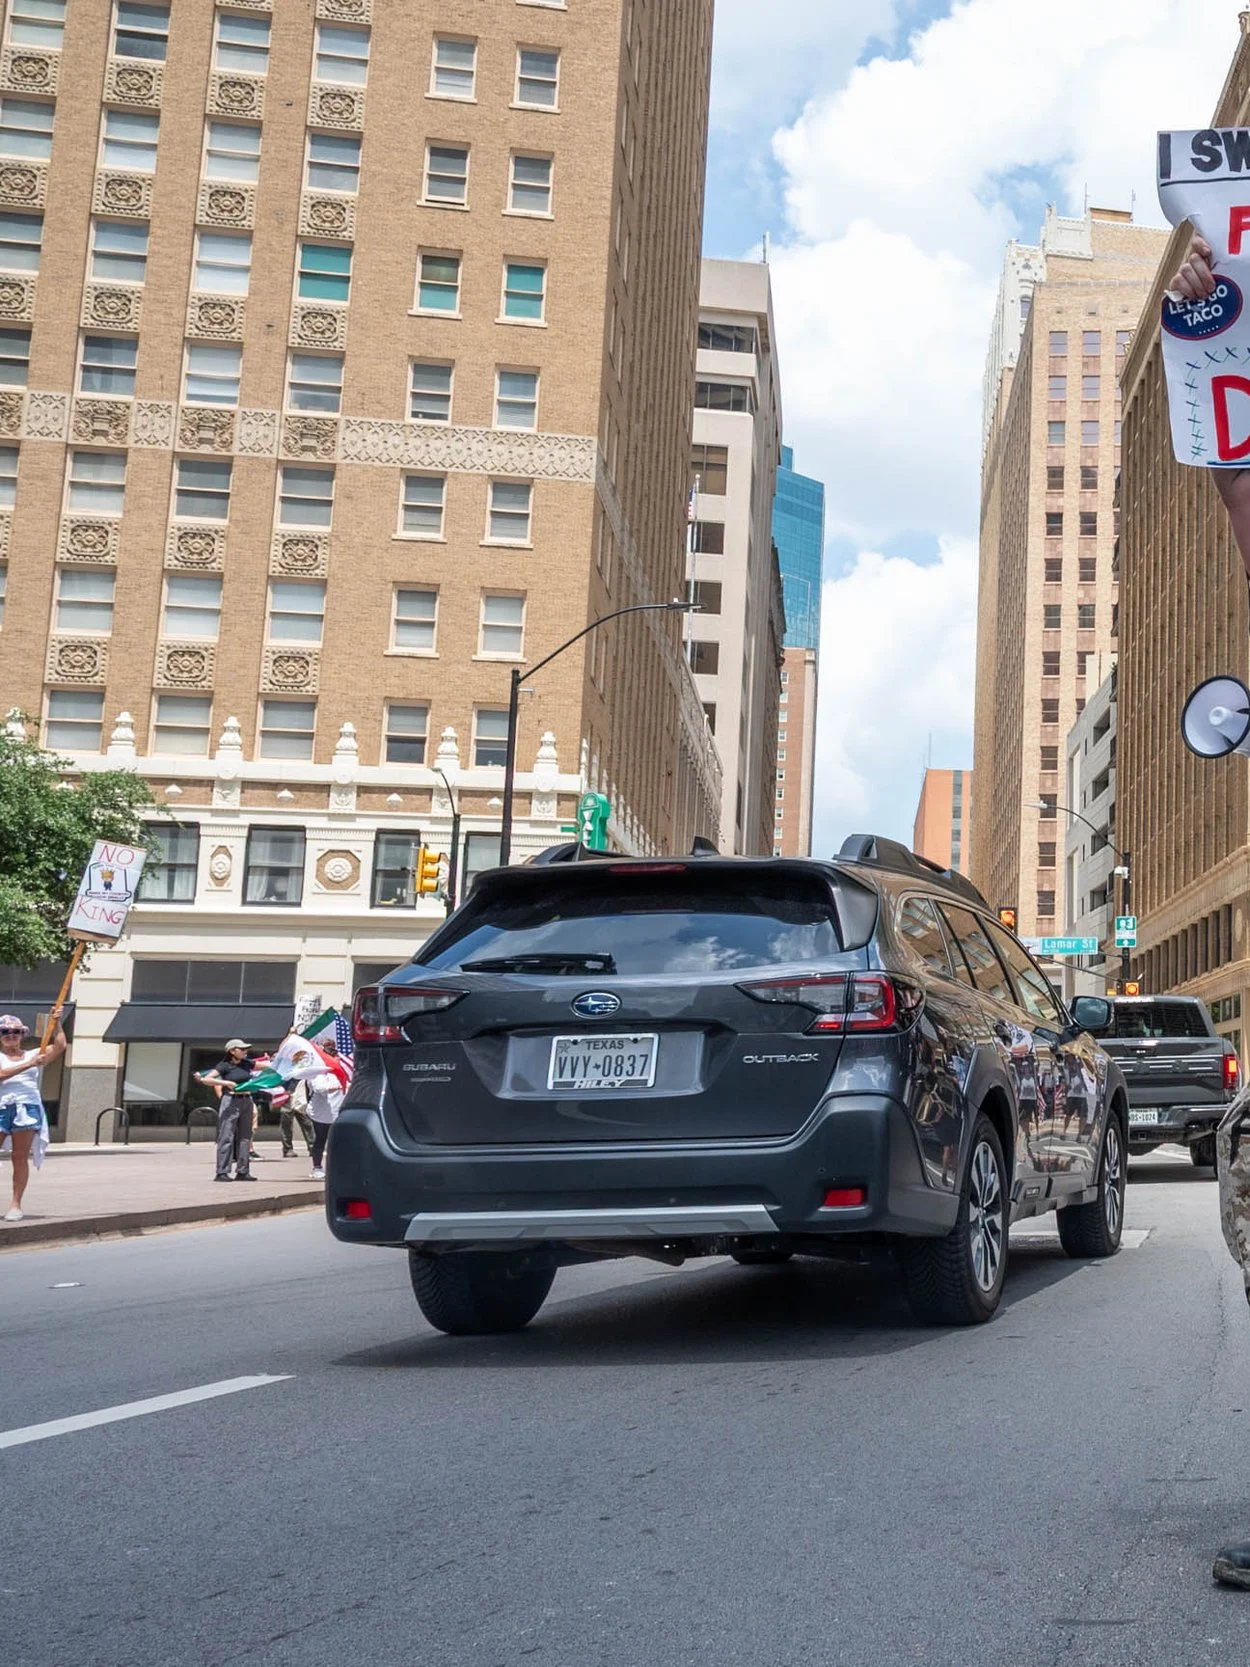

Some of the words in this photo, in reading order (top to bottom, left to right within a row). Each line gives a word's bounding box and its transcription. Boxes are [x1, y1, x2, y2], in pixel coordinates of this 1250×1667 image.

[1159, 133, 1172, 179] I
[1183, 304, 1223, 327] TACO
[98, 844, 135, 866] NO
[75, 895, 126, 925] KING
[1044, 939, 1076, 949] Lamar
[1081, 938, 1094, 949] St
[585, 1040, 625, 1051] TEXAS
[742, 1053, 819, 1064] OUTBACK
